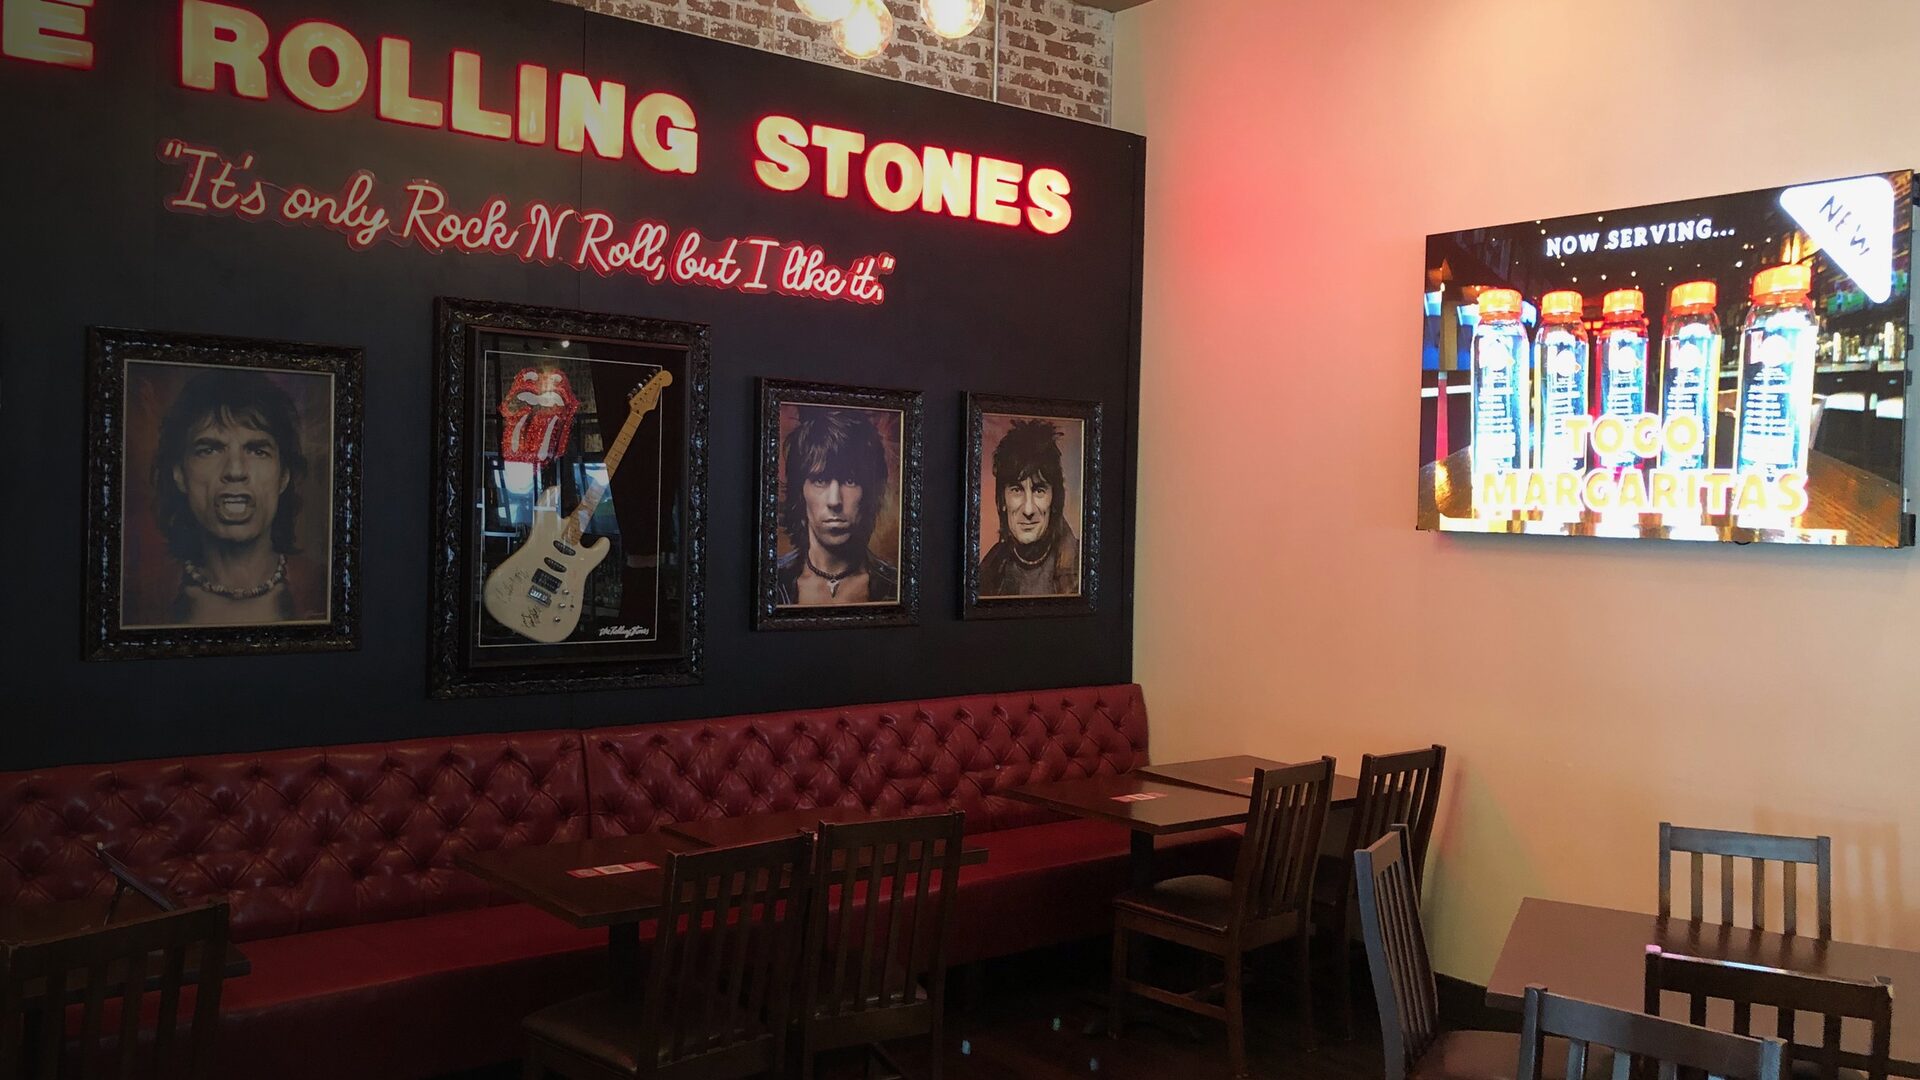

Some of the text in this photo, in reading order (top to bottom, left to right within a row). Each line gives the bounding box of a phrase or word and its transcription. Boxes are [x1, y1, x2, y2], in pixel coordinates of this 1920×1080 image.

[181, 0, 698, 174] ROLLING
[754, 115, 1073, 235] STONES
[283, 174, 390, 246] only
[403, 184, 520, 249] Rock
[577, 212, 667, 281] Roll,
[676, 232, 742, 285] but
[743, 238, 780, 289] I
[781, 245, 847, 297] like
[1545, 217, 1736, 257] NOW SERVING...
[1818, 194, 1871, 257] NEW
[1564, 414, 1700, 455] TOGO
[1480, 470, 1805, 513] MARGARITAS
